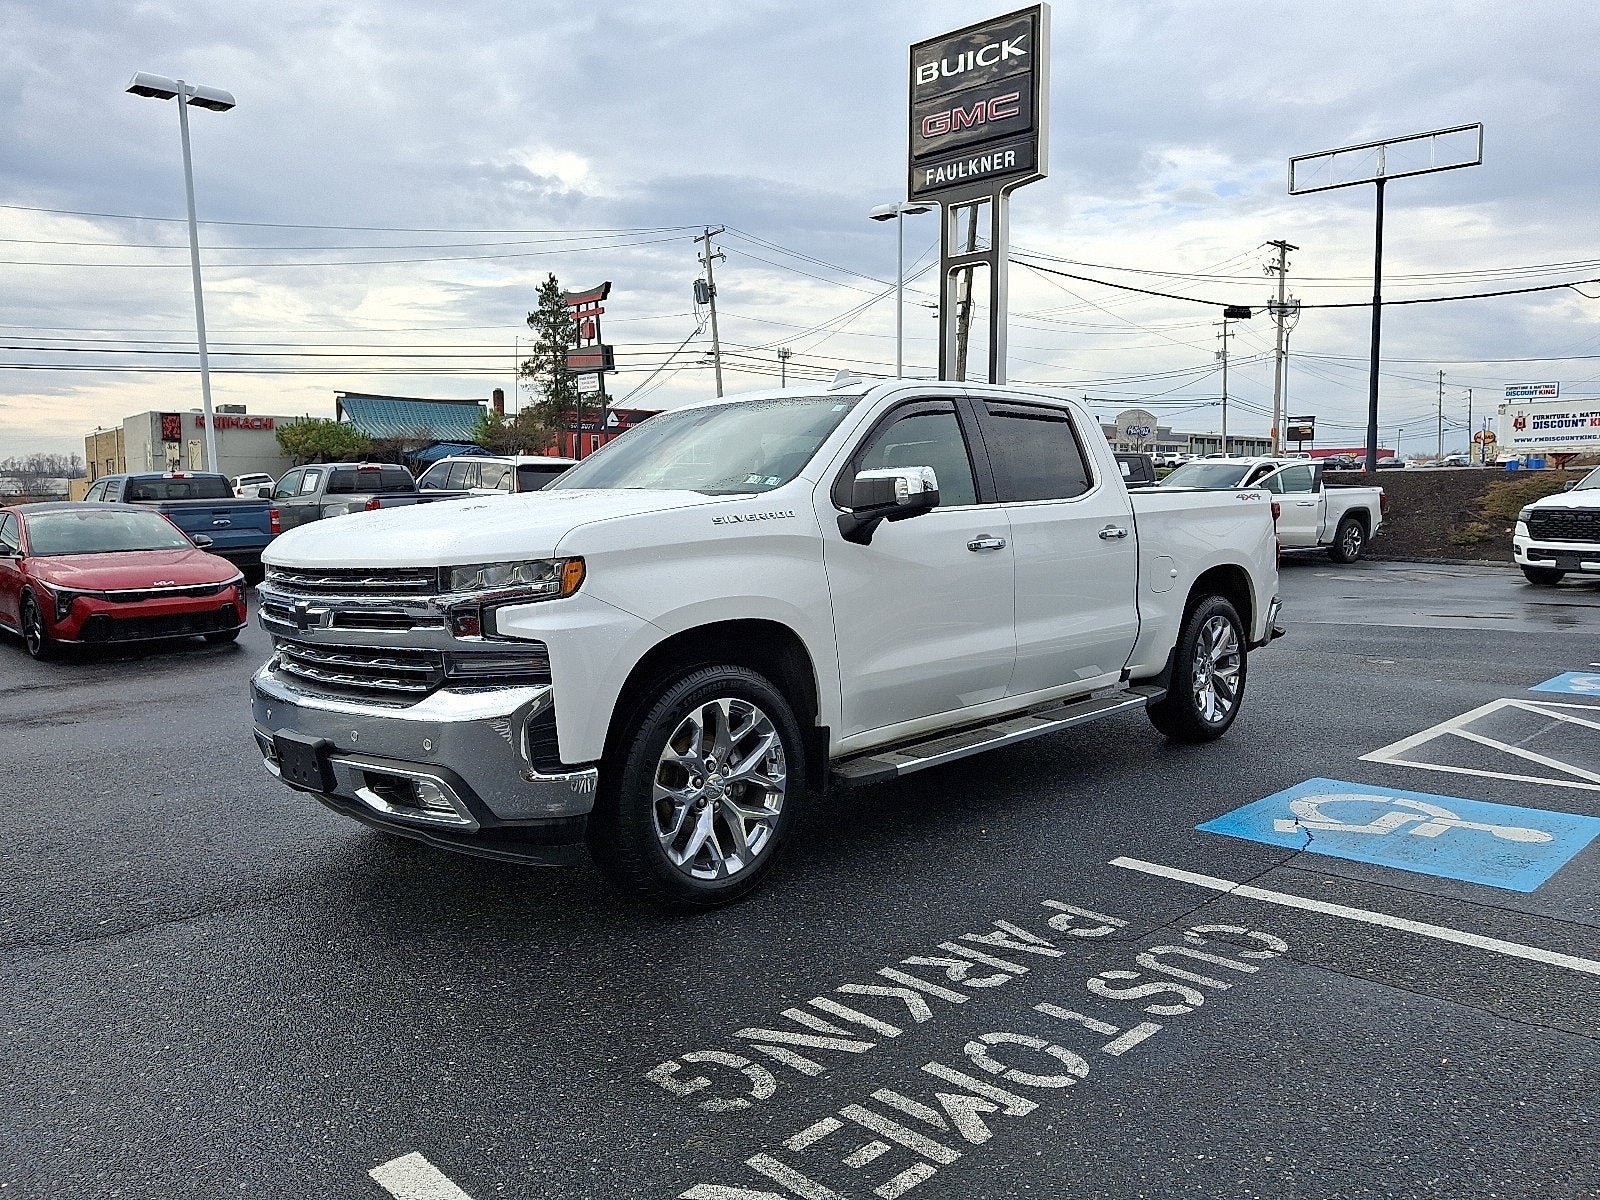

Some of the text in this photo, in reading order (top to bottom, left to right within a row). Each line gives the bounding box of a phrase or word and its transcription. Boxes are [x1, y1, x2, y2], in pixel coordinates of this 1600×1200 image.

[916, 33, 1028, 86] BUICK
[922, 91, 1020, 139] GMC
[926, 150, 1016, 186] FAULKNER
[1532, 413, 1570, 421] FURNITURE
[1532, 418, 1587, 430] DISCOUNT
[712, 510, 796, 525] SILVERADO
[645, 899, 1129, 1112] PARKING
